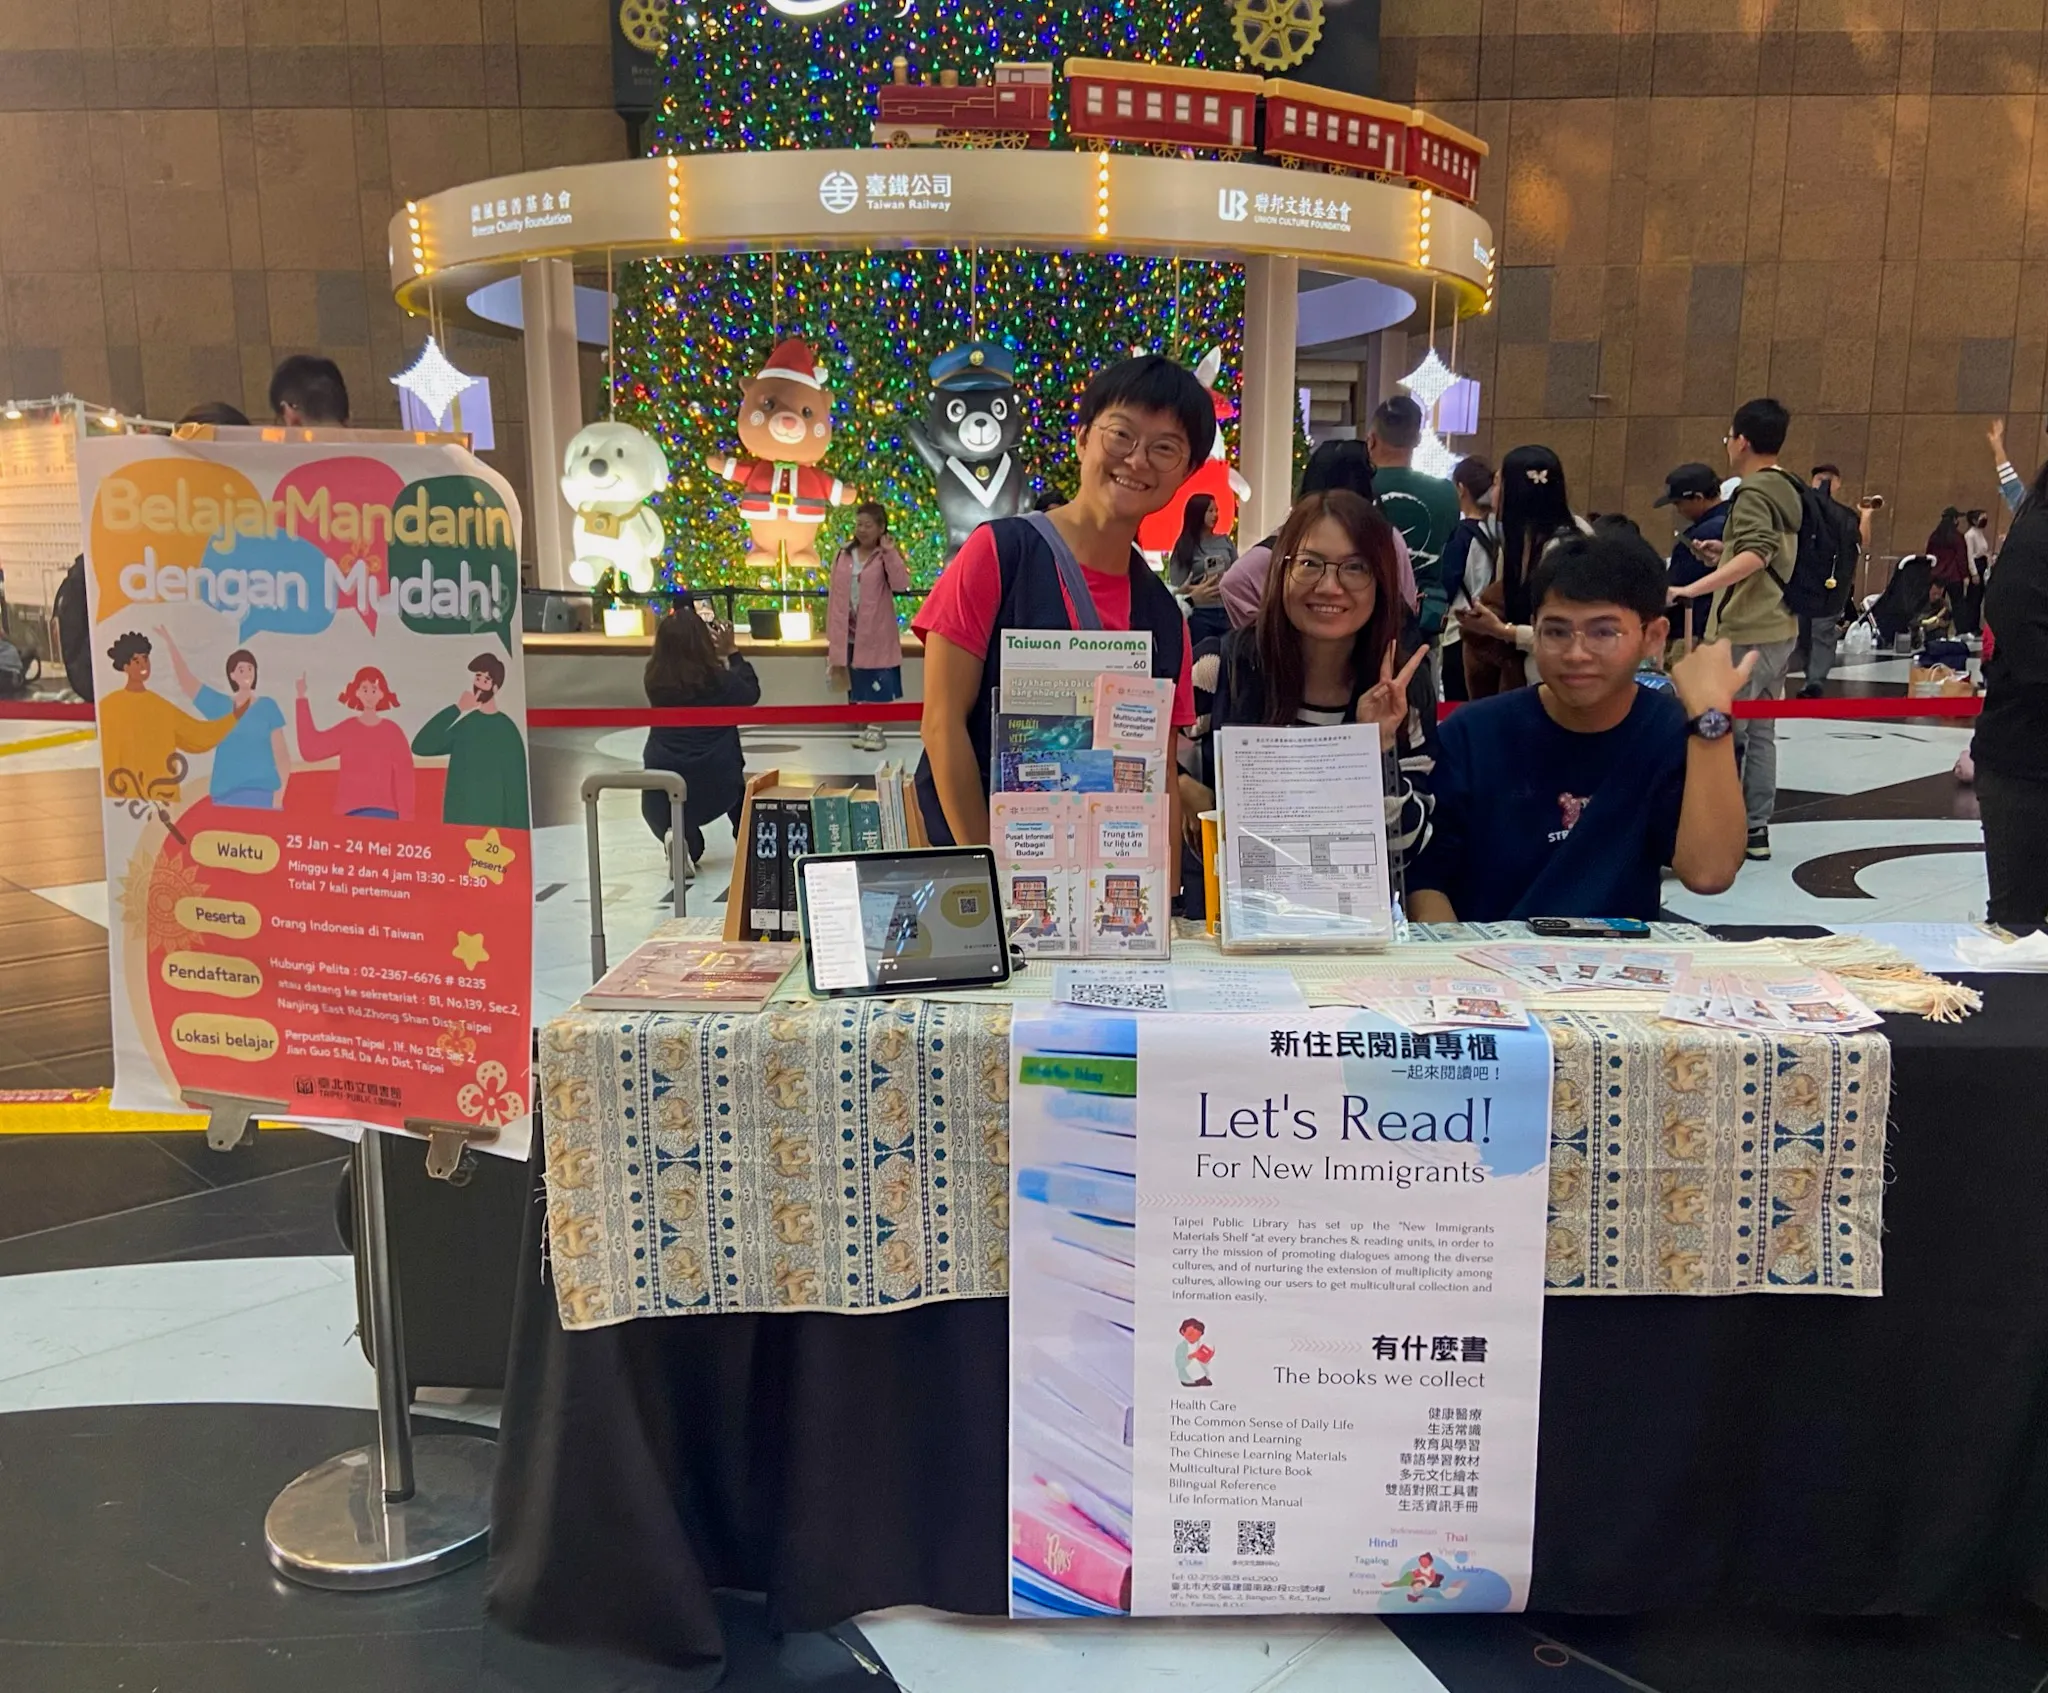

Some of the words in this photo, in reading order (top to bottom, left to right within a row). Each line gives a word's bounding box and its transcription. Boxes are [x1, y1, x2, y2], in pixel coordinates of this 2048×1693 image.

[865, 172, 951, 197] 臺鐵公司
[866, 199, 905, 210] Taiwan
[908, 199, 951, 212] Railway
[1253, 192, 1351, 223] 聯邦文教基金會
[1254, 215, 1278, 225] UNION
[1279, 217, 1309, 228] CULTURE
[1311, 220, 1351, 232] FOUNDATION
[100, 476, 286, 555] Belajar
[286, 484, 513, 550] Mandarin
[119, 546, 307, 628] dengan
[324, 556, 502, 624] Mudah!
[1006, 636, 1061, 650] Taiwan
[1069, 637, 1147, 650] Panorama
[1133, 660, 1147, 669] 60
[1113, 713, 1156, 723] Multicultural
[1113, 721, 1153, 730] Information
[1121, 730, 1144, 738] Center
[1102, 830, 1125, 839] Trung
[216, 841, 264, 861] Waktu
[286, 834, 303, 849] 25
[307, 836, 329, 851] Jan
[345, 839, 363, 854] 24
[368, 841, 392, 856] Mei
[396, 843, 432, 859] 2026
[485, 843, 500, 855] 20
[1014, 841, 1045, 849] Pelbagai
[1132, 840, 1142, 848] đa
[1016, 849, 1044, 857] Budaya
[288, 859, 328, 876] Minggu
[331, 863, 345, 875] ke
[347, 864, 355, 877] 2
[358, 865, 378, 878] dan
[381, 868, 390, 879] 4
[391, 868, 412, 883] jam
[416, 870, 446, 884] 13:30
[459, 874, 488, 888] 15:30
[471, 858, 508, 874] peserta
[288, 877, 316, 891] Total
[319, 880, 326, 892] 7
[329, 880, 348, 894] kali
[351, 885, 411, 899] pertemuan
[195, 907, 246, 925] Peserta
[271, 916, 307, 933] Orang
[310, 919, 365, 936] Indonesia
[368, 924, 379, 937] di
[382, 926, 424, 942] Taiwan
[168, 963, 260, 985] Pendaftaran
[269, 957, 315, 974] Hubungi
[319, 961, 350, 975] Pelita
[360, 966, 442, 985] 02-2367-6676
[458, 976, 487, 990] 8235
[278, 979, 302, 991] atau
[304, 981, 342, 998] datang
[344, 985, 357, 997] ke
[360, 988, 418, 1004] sekretariat
[176, 1028, 220, 1046] Lokasi
[225, 1031, 275, 1052] belajar
[1269, 1030, 1499, 1061] 新住民閱讀專櫃
[1199, 1092, 1318, 1141] Let's
[1341, 1094, 1494, 1144] Read!
[1196, 1154, 1242, 1180] For
[1251, 1154, 1314, 1181] New
[1324, 1156, 1486, 1189] Immigrants
[1172, 1216, 1204, 1229] Taipei
[1212, 1216, 1245, 1228] Public
[1252, 1218, 1289, 1231] Library
[1298, 1218, 1317, 1229] has
[1325, 1220, 1340, 1230] set
[1350, 1222, 1364, 1233] up
[1372, 1221, 1390, 1231] the
[1435, 1222, 1495, 1235] Immigrants
[1172, 1231, 1220, 1242] Materials
[1222, 1231, 1249, 1243] Shelf
[1267, 1235, 1297, 1246] every
[1299, 1234, 1348, 1245] branches
[1363, 1236, 1404, 1248] reading
[1407, 1237, 1435, 1248] units,
[1438, 1237, 1448, 1247] in
[1451, 1238, 1480, 1248] order
[1483, 1238, 1494, 1248] to
[1172, 1290, 1232, 1301] information
[1234, 1291, 1267, 1304] easily.
[1371, 1334, 1489, 1363] 有什麼書
[1273, 1366, 1311, 1384] The
[1318, 1367, 1378, 1386] books
[1384, 1372, 1413, 1386] we
[1419, 1370, 1486, 1388] collect
[1170, 1399, 1206, 1411] Health
[1210, 1400, 1237, 1412] Care
[1428, 1407, 1482, 1421] 健康醫療
[1170, 1415, 1191, 1426] The
[1194, 1416, 1246, 1428] Common
[1249, 1417, 1283, 1429] Sense
[1286, 1418, 1299, 1429] of
[1301, 1418, 1330, 1431] Daily
[1333, 1419, 1355, 1430] Life
[1427, 1422, 1481, 1436] 生活常識
[1170, 1431, 1225, 1443] Education
[1228, 1432, 1250, 1443] and
[1253, 1433, 1303, 1446] Learning
[1413, 1437, 1480, 1451] 教育與學習
[1170, 1446, 1191, 1458] The
[1193, 1447, 1240, 1459] Chinese
[1243, 1448, 1293, 1462] Learning
[1295, 1450, 1348, 1462] Materials
[1399, 1452, 1480, 1467] 華語學習教材
[1169, 1463, 1240, 1475] Multicultural
[1243, 1464, 1282, 1476] Picture
[1285, 1465, 1313, 1477] Book
[1399, 1468, 1480, 1482] 多元文化繪本
[1169, 1478, 1217, 1490] Bilingual
[1220, 1479, 1277, 1491] Reference
[1385, 1483, 1479, 1497] 雙語對照工具書
[1169, 1493, 1190, 1504] Life
[1193, 1493, 1258, 1506] Information
[1261, 1495, 1303, 1507] Manual
[1398, 1498, 1478, 1513] 生活資訊手冊
[1368, 1537, 1398, 1548] Hindi
[1444, 1531, 1468, 1543] Thai
[1354, 1555, 1389, 1566] Tagalog
[1349, 1571, 1376, 1580] Korea
